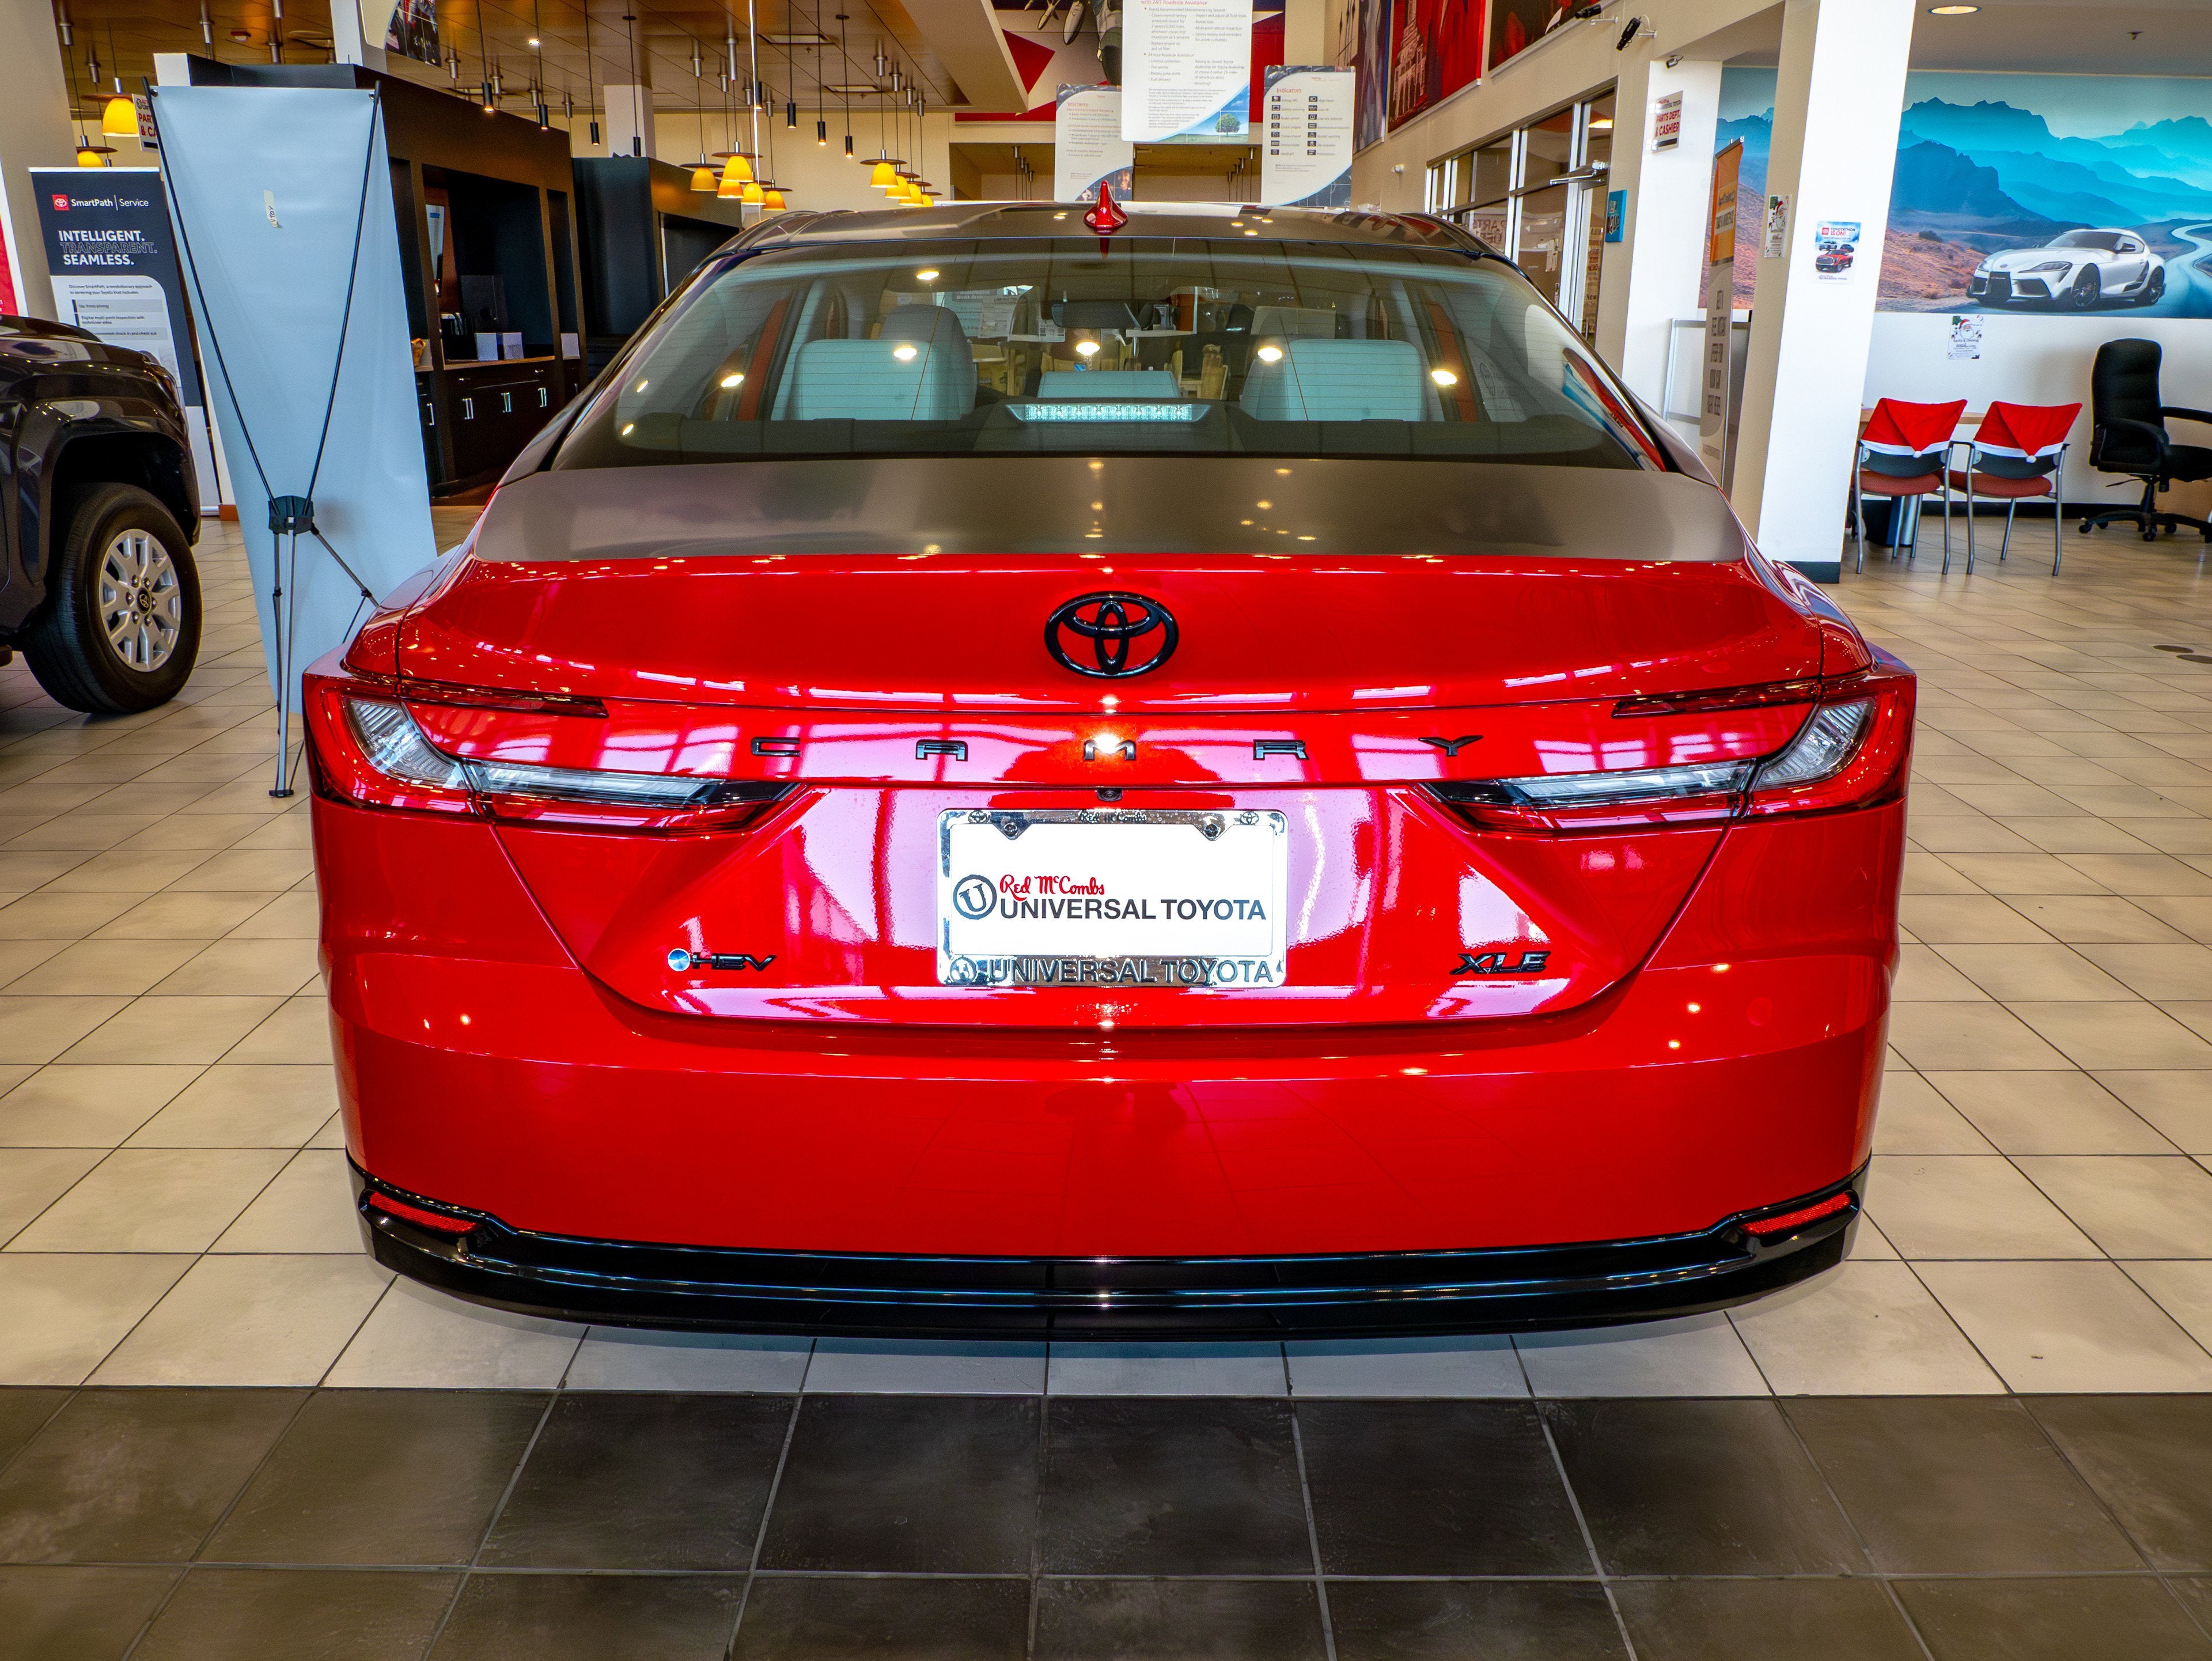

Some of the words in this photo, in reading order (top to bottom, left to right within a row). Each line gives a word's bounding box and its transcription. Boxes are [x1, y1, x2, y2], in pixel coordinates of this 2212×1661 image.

[1659, 122, 1680, 136] CASHIER
[71, 199, 113, 207] SmartPath
[119, 199, 149, 207] Service
[58, 230, 145, 241] INTELLIGENT.
[60, 243, 158, 253] TRANSPARENT.
[63, 254, 135, 265] SEAMLESS.
[751, 735, 1483, 761] CAMRY
[999, 874, 1031, 901] Red
[1034, 876, 1105, 895] McCombs
[1001, 898, 1156, 919] UNIVERSAL
[1161, 899, 1266, 920] TOYOTA
[692, 952, 777, 972] HEV
[988, 958, 1157, 983] UNIVERSAL
[1159, 959, 1273, 983] TOYOTA
[1449, 951, 1551, 975] XLE
